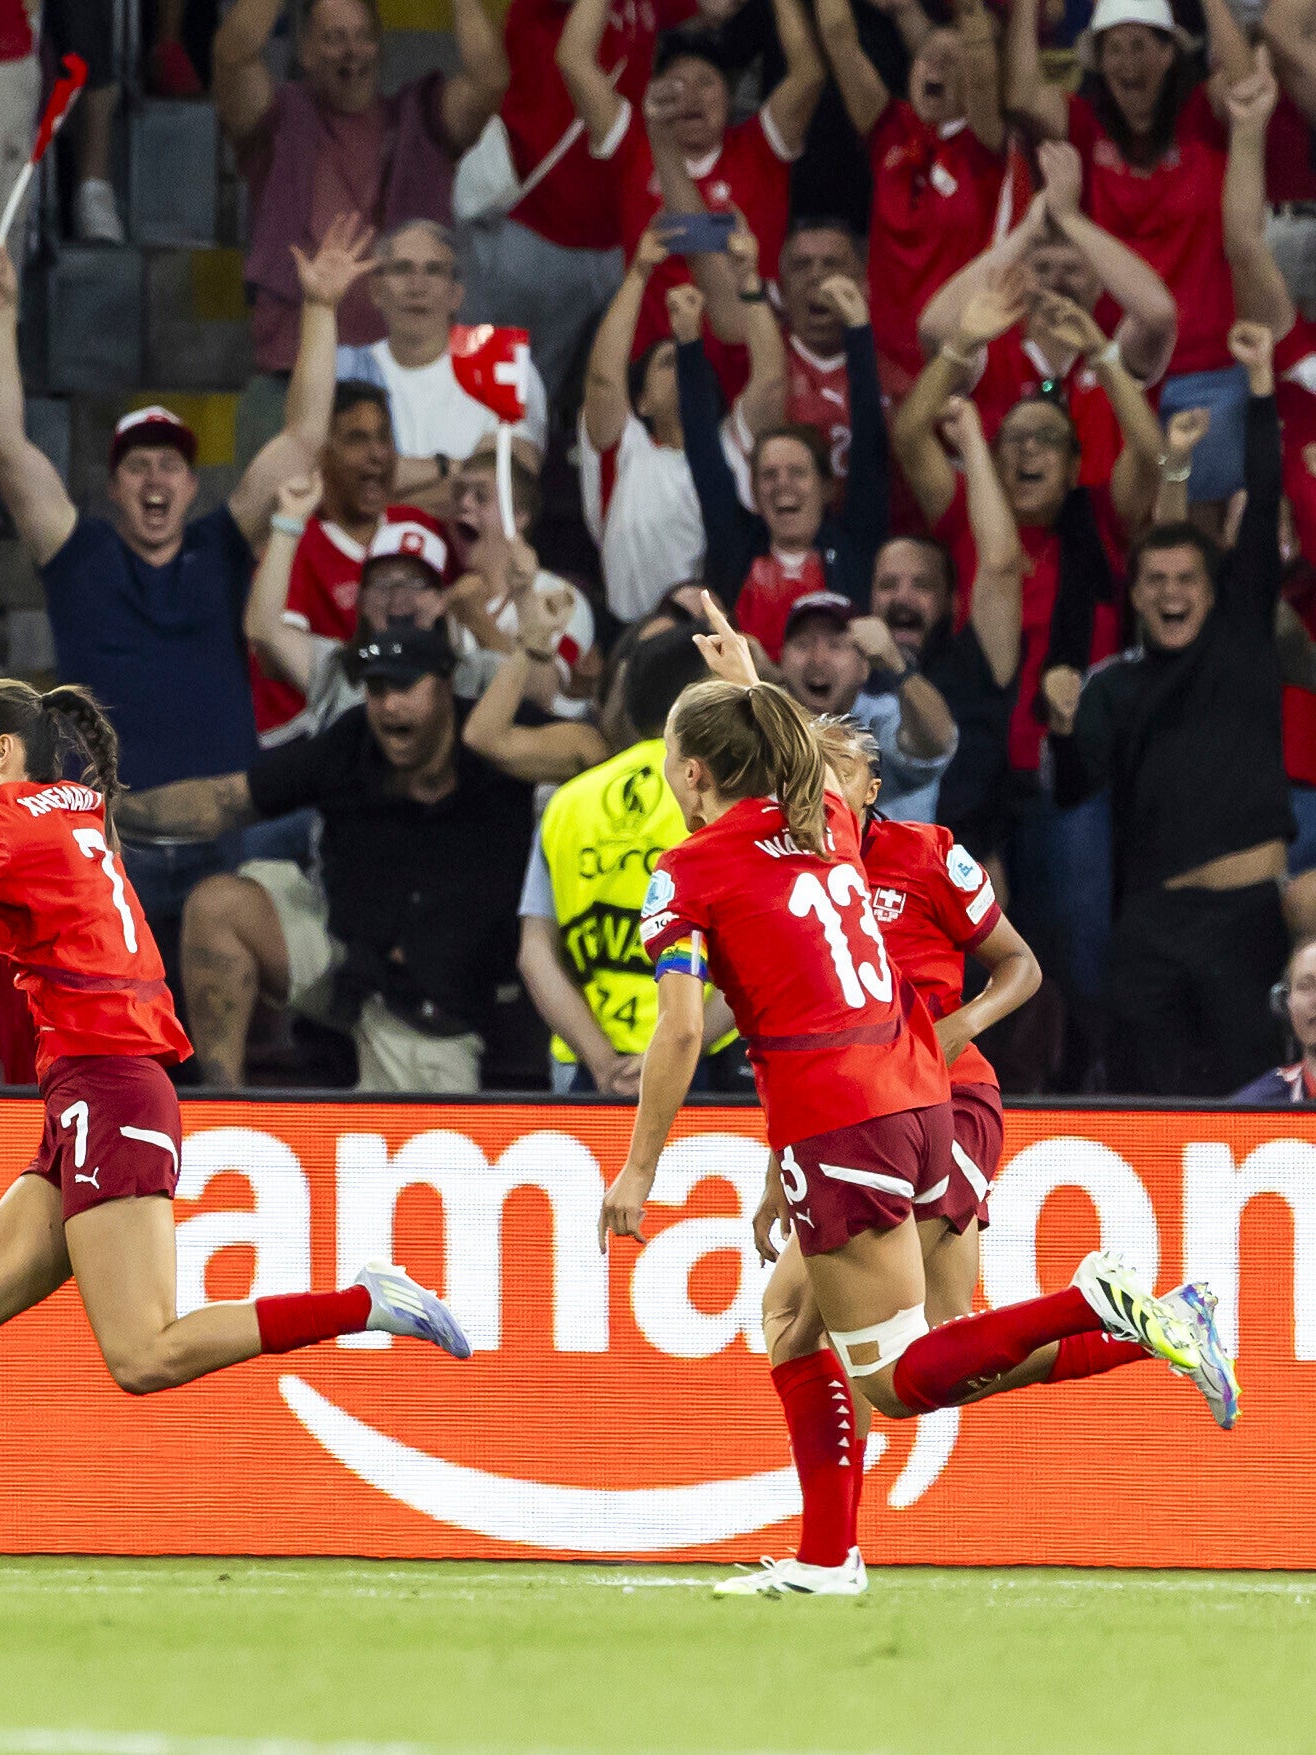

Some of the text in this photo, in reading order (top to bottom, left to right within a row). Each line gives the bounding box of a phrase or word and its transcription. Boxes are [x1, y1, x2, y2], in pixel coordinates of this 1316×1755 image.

[72, 828, 138, 954] 7
[788, 863, 893, 1009] 13
[60, 1100, 89, 1168] 7
